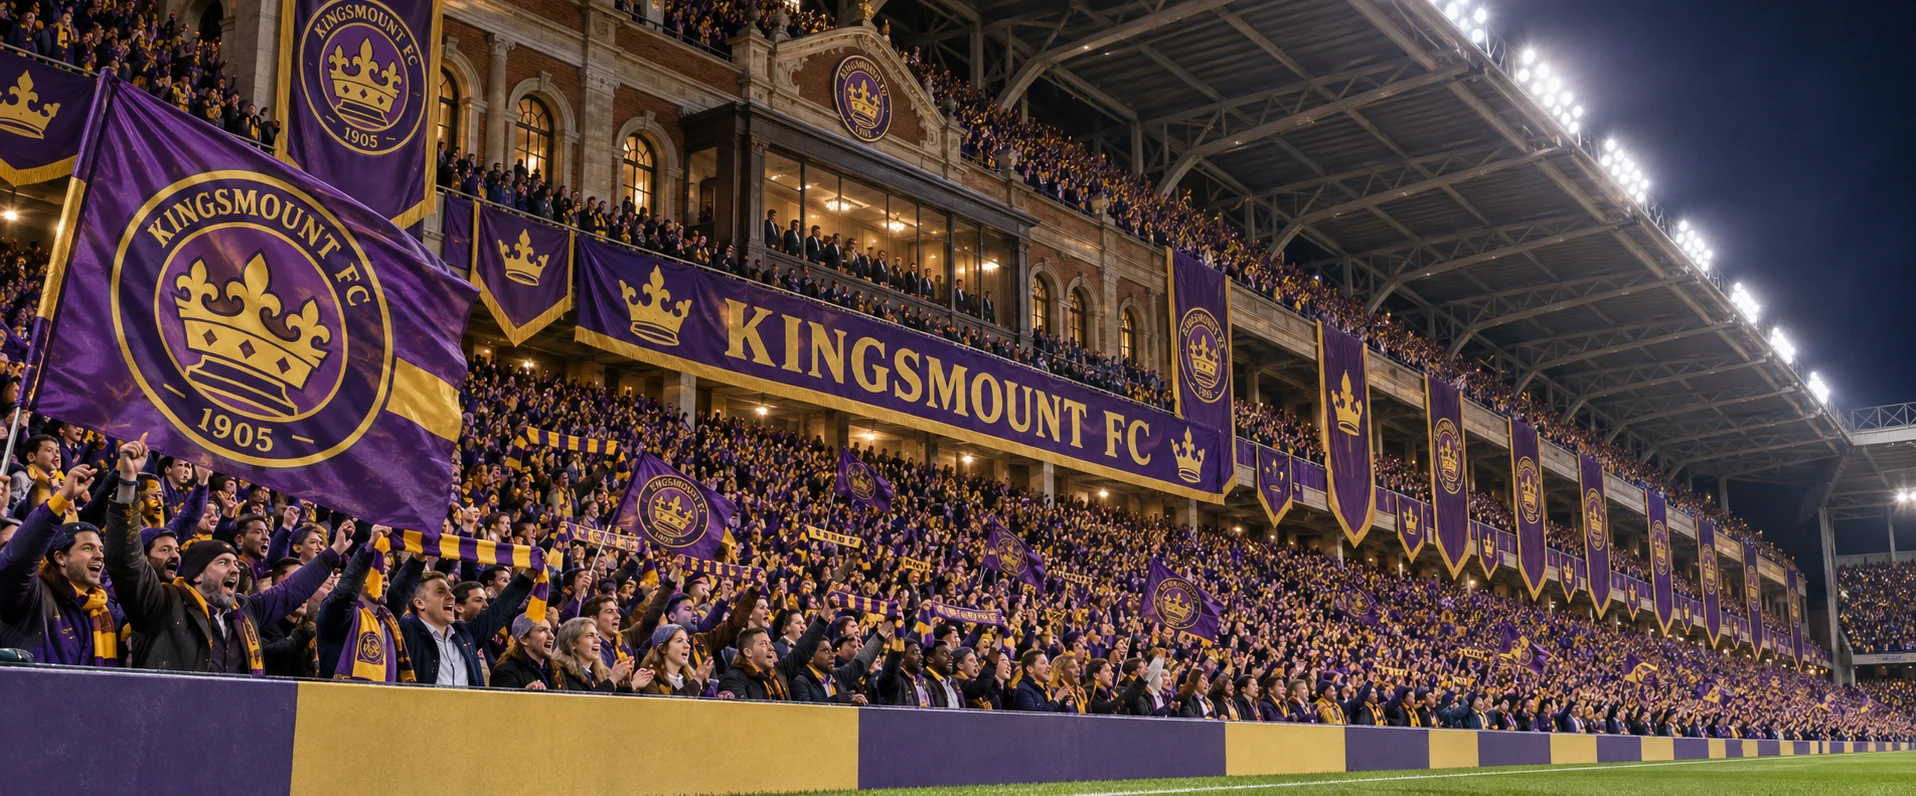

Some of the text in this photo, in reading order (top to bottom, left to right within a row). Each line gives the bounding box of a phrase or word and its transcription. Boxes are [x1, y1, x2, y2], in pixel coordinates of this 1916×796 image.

[314, 8, 418, 66] KINGSMOUNT FC
[343, 126, 378, 148] 1905
[147, 188, 370, 307] KINGSMOUNT FC
[723, 297, 1151, 467] KINGSMOUNT FC
[197, 408, 274, 452] 1905
